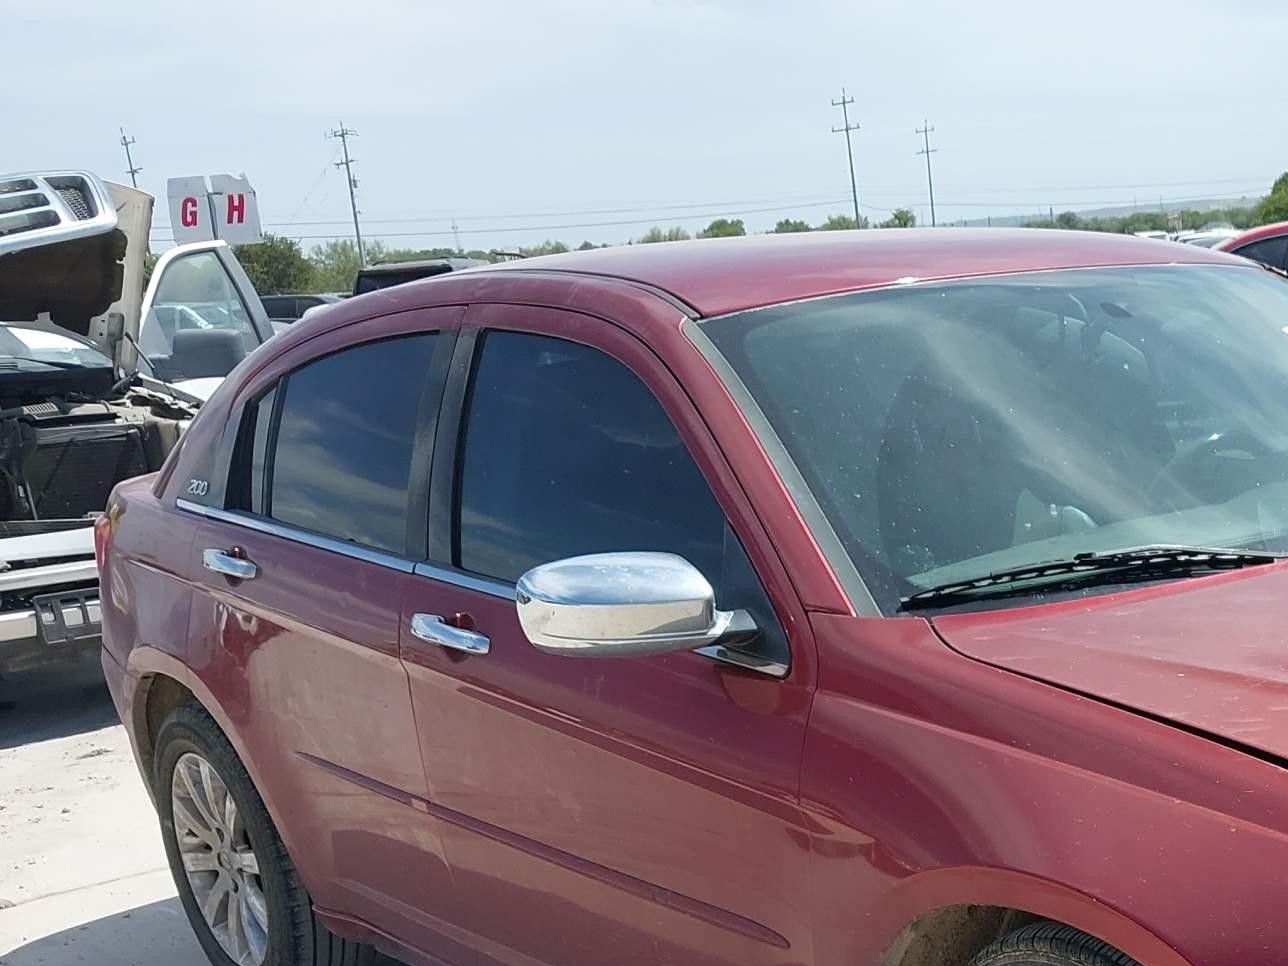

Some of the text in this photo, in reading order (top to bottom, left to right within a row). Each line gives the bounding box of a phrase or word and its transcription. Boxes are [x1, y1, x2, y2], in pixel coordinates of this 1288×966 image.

[181, 197, 198, 227] G
[226, 193, 245, 225] H
[187, 479, 208, 496] 200
